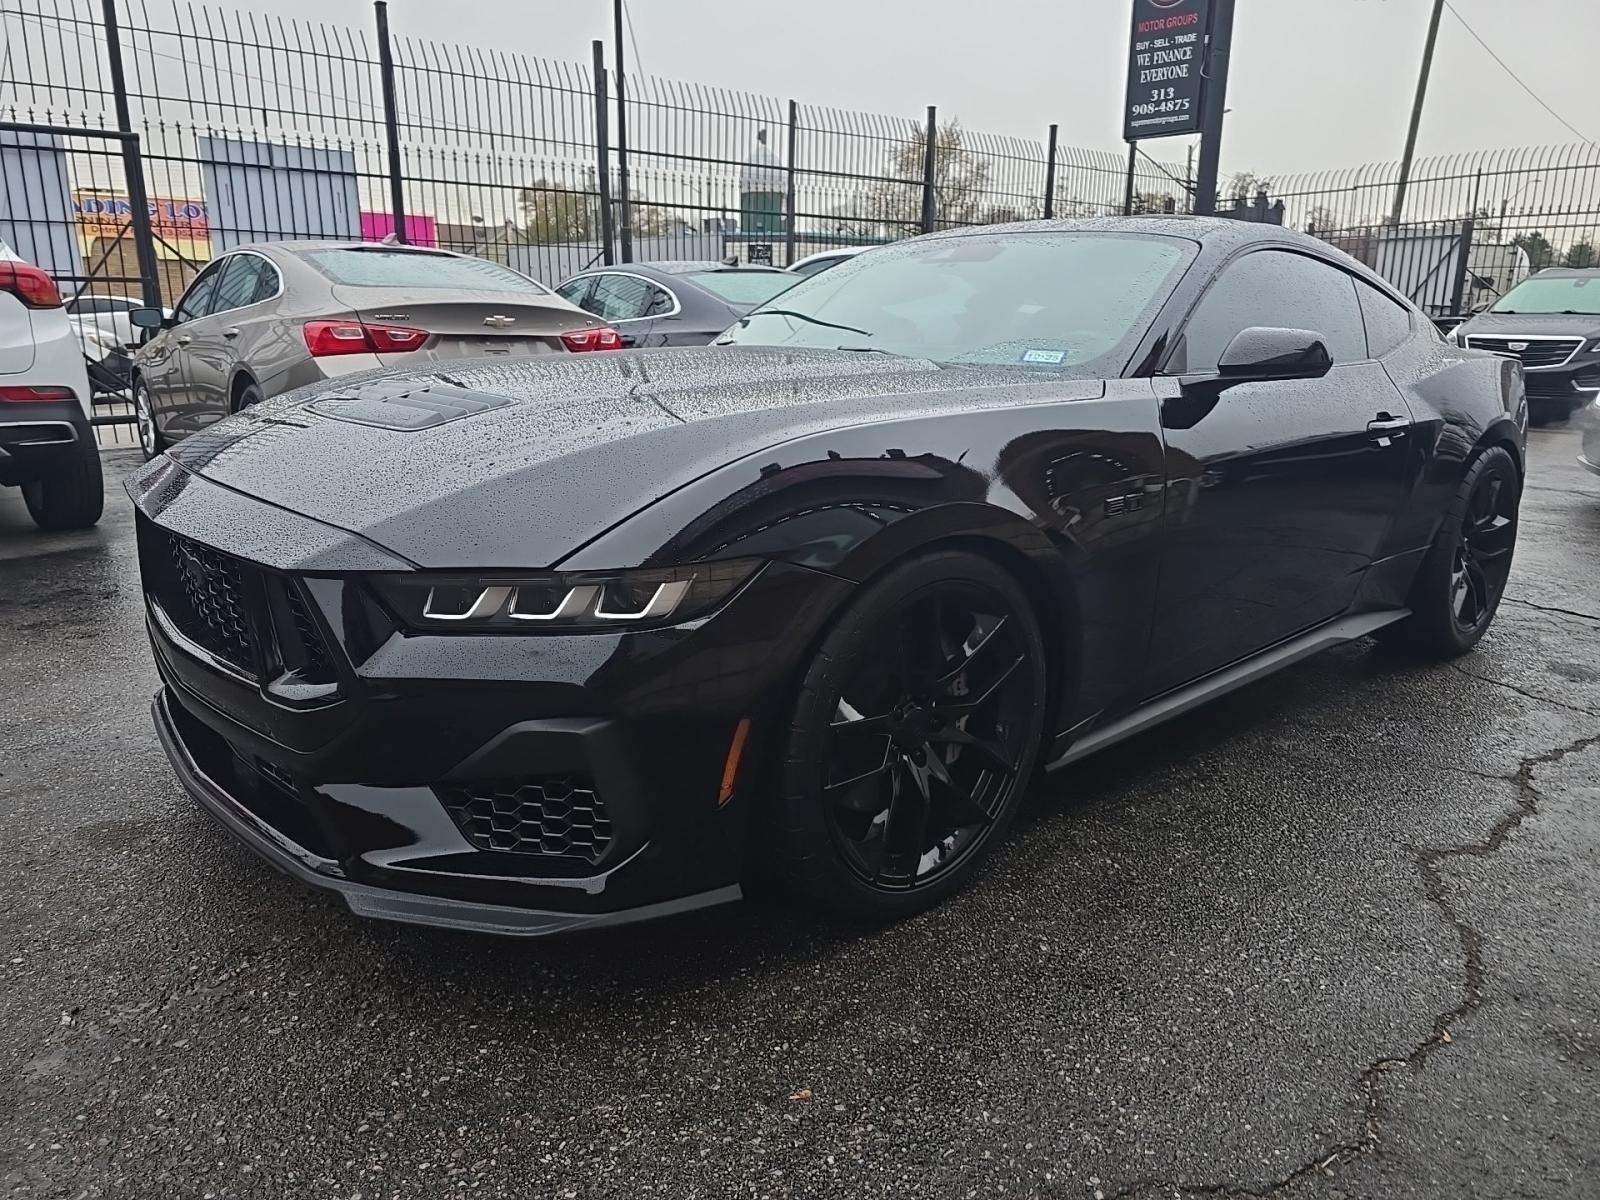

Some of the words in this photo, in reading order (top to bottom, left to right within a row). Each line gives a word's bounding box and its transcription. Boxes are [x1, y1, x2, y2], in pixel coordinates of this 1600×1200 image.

[1138, 19, 1165, 33] MOTOR
[1166, 13, 1198, 28] GROUPS
[1136, 40, 1149, 50] BUY
[1154, 38, 1170, 48] SELL
[1175, 33, 1197, 44] TRADE
[1137, 53, 1150, 66] WE
[1153, 46, 1193, 65] FINANCE
[1140, 64, 1189, 83] EVERYONE
[1150, 87, 1175, 101] 313
[1132, 98, 1190, 116] 908-4875
